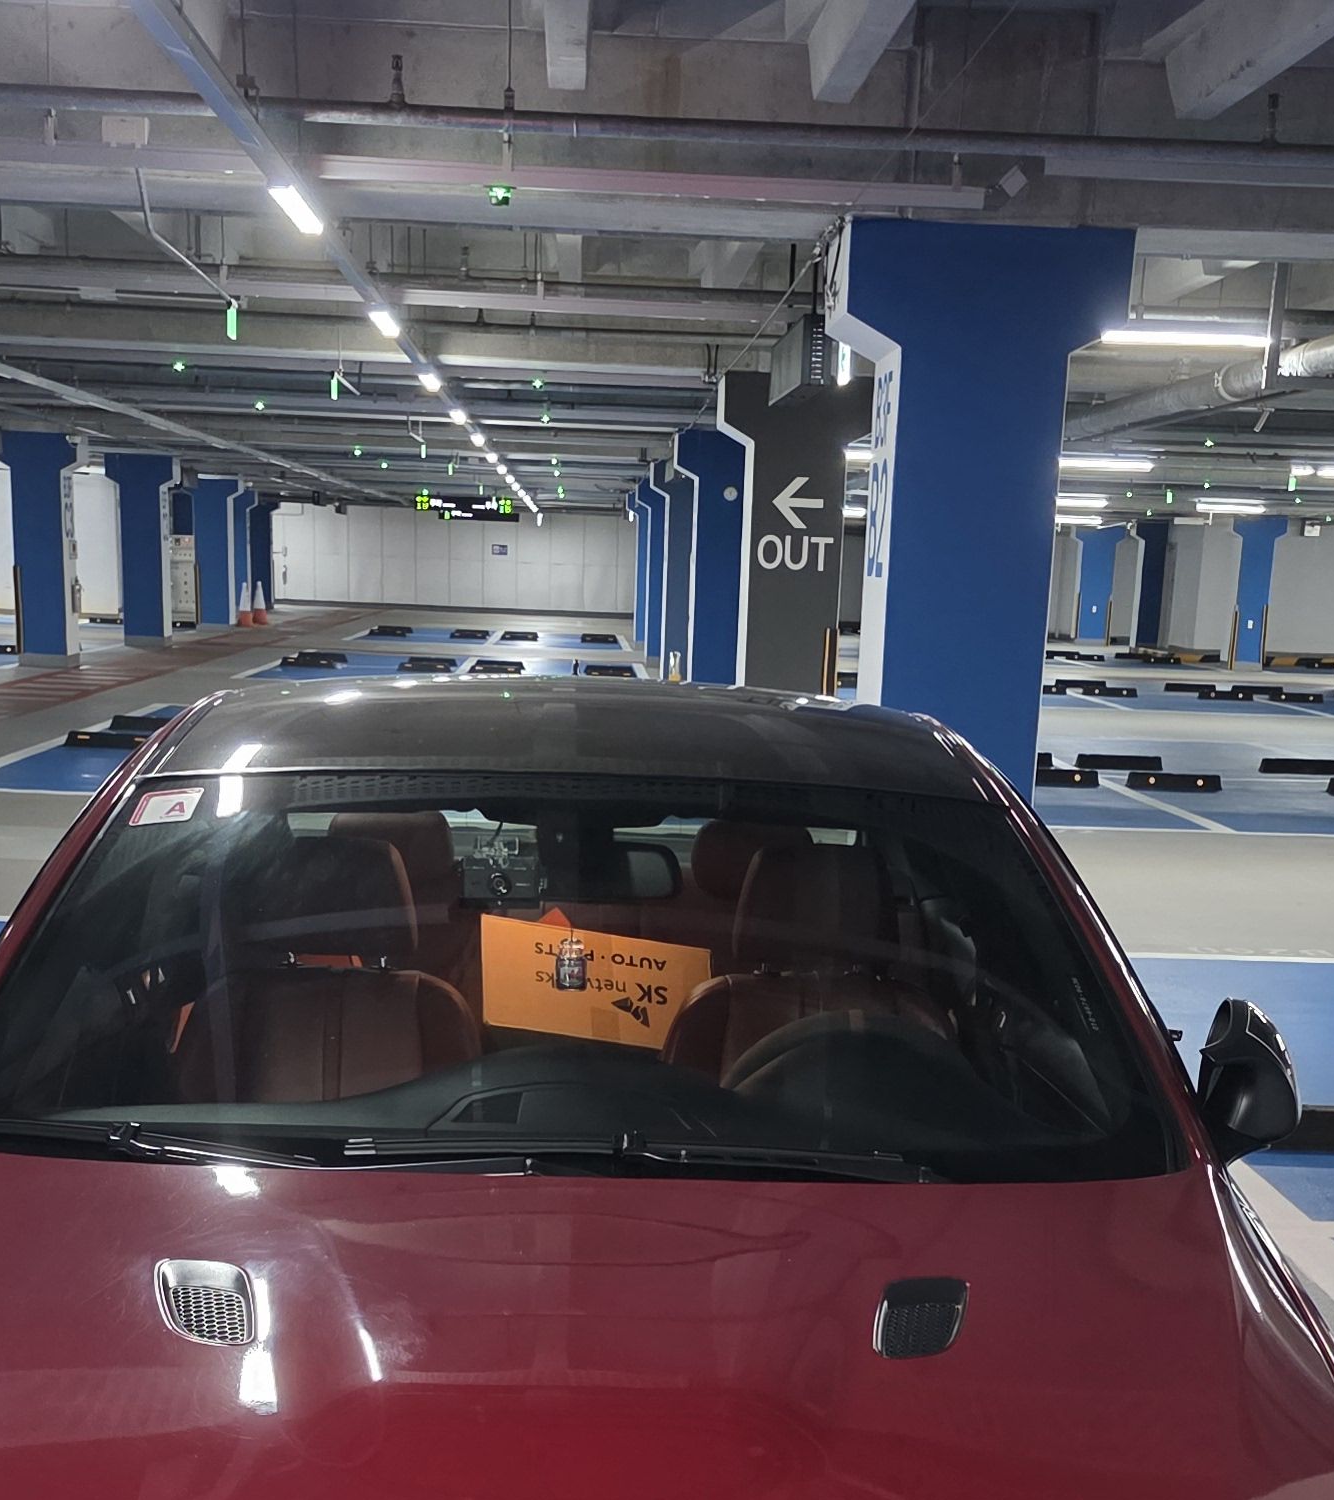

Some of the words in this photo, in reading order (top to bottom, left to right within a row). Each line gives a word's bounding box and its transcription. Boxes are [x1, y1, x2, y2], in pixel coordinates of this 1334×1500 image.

[867, 458, 889, 578] B2
[757, 534, 835, 572] OUT
[164, 801, 186, 816] A
[534, 941, 595, 962] PTS
[636, 982, 668, 1005] SK
